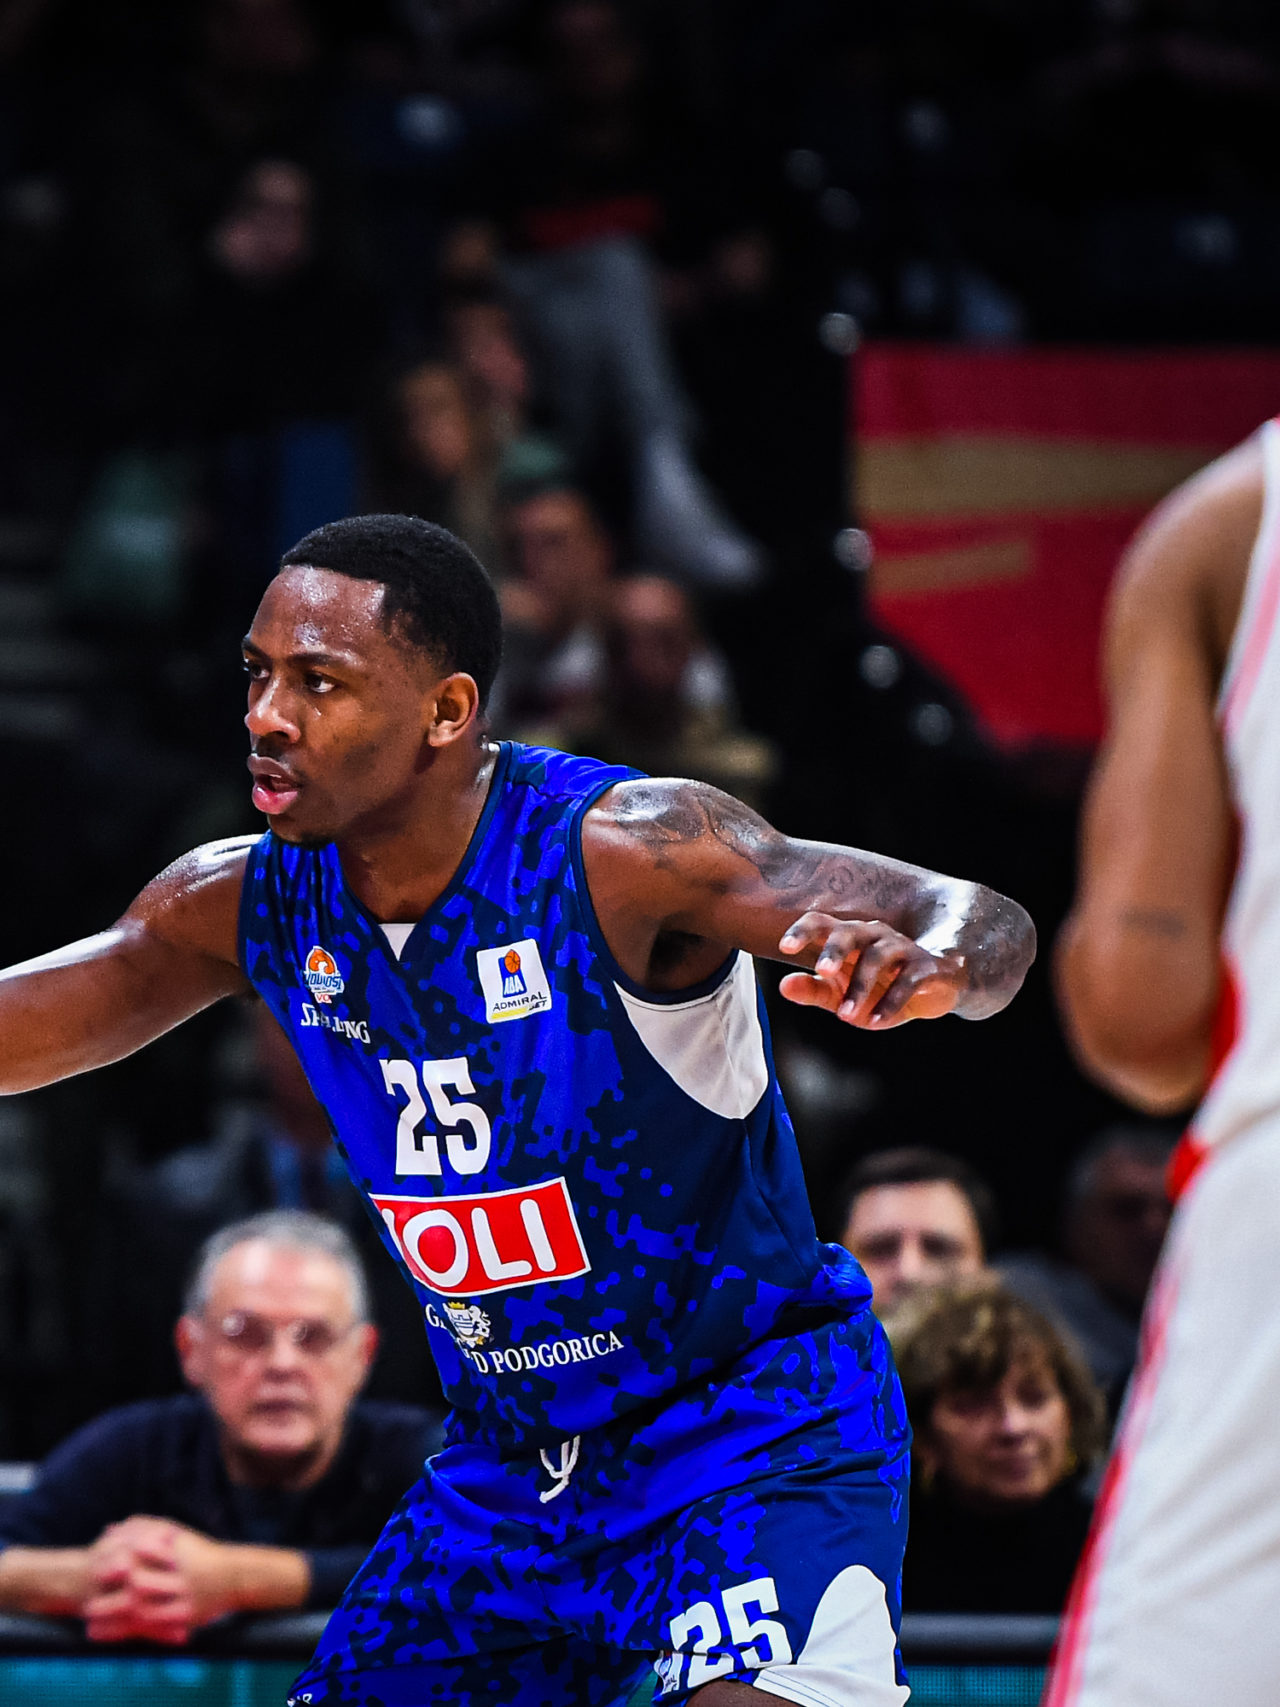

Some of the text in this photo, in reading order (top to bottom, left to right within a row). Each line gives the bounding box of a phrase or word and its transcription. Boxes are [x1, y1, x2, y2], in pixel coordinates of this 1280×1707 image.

[493, 992, 547, 1011] ADMIRAL
[379, 1057, 491, 1175] 25
[489, 1331, 624, 1373] PODGORICA
[670, 1577, 792, 1688] 25
